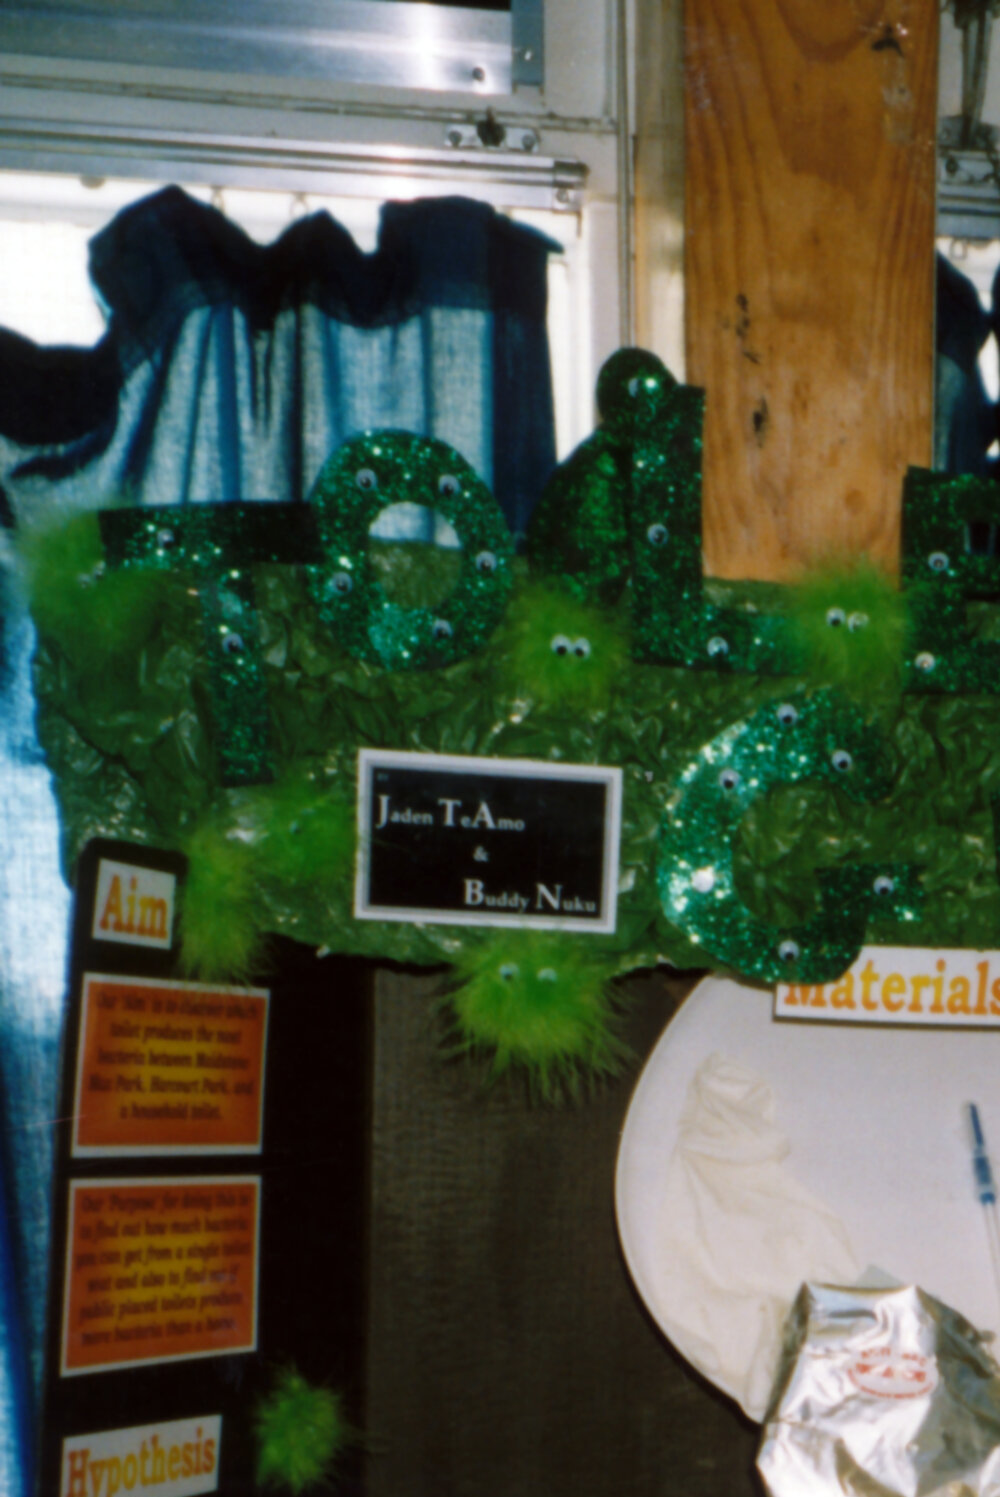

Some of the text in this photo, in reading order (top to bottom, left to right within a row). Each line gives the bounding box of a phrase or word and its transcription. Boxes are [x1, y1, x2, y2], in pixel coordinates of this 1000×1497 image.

[375, 795, 434, 829] Jaden
[472, 846, 489, 862] &
[99, 874, 168, 939] Aim
[463, 879, 598, 913] Buddy Nuku
